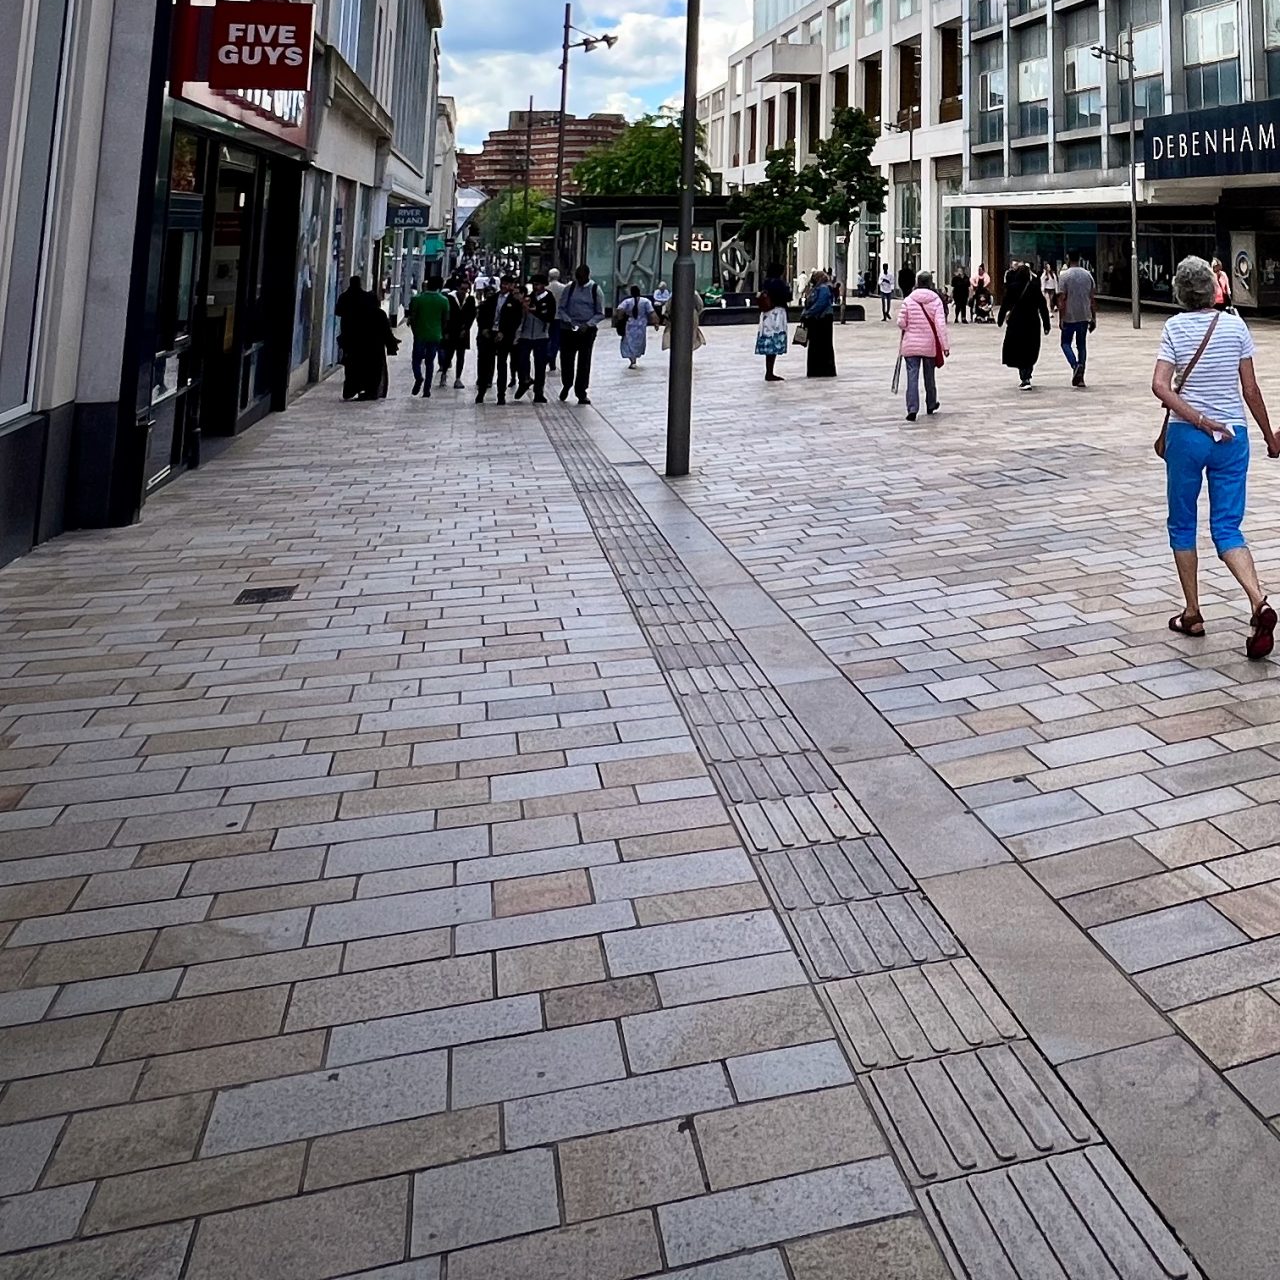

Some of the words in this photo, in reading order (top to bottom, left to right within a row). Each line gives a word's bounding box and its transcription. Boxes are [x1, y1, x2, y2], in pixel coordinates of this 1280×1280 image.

[228, 23, 296, 44] FIVE
[218, 45, 303, 67] GUYS
[398, 208, 421, 217] RIVER
[664, 240, 712, 251] NRO
